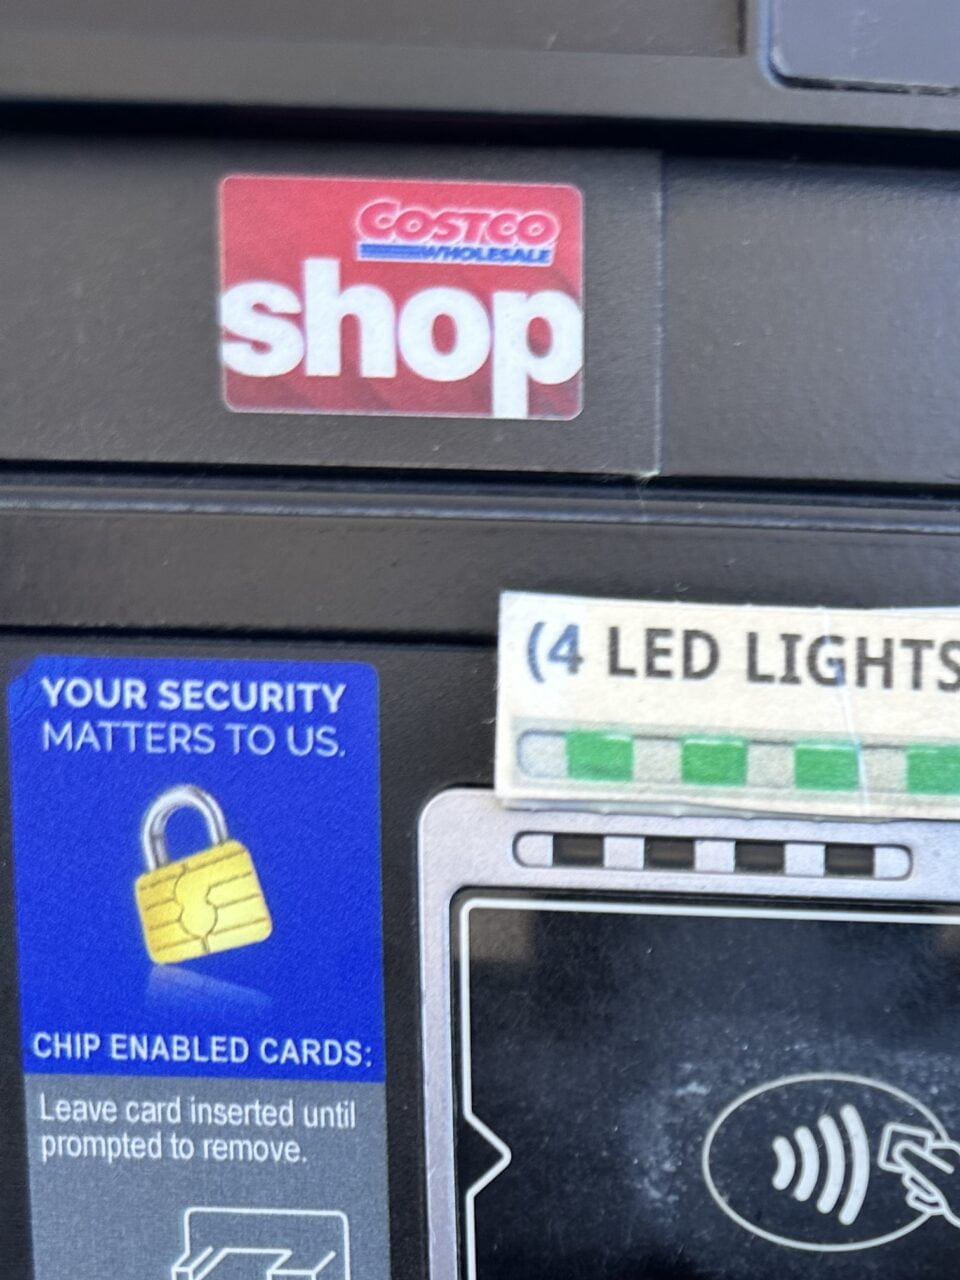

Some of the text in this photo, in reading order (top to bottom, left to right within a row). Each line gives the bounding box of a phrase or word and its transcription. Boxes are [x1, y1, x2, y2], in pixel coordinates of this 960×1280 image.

[356, 199, 560, 246] COSTCO
[421, 244, 551, 263] WHOLESALE
[220, 257, 583, 419] shop
[527, 621, 583, 683] (4
[608, 625, 719, 680] LED
[41, 677, 346, 713] YOUR SECURITY
[42, 720, 346, 758] MATTERS TO US.
[33, 1032, 373, 1068] CHIP ENABLED CARDS:
[40, 1092, 356, 1128] Leave card inserted until
[41, 1132, 308, 1164] prompted to remove.
